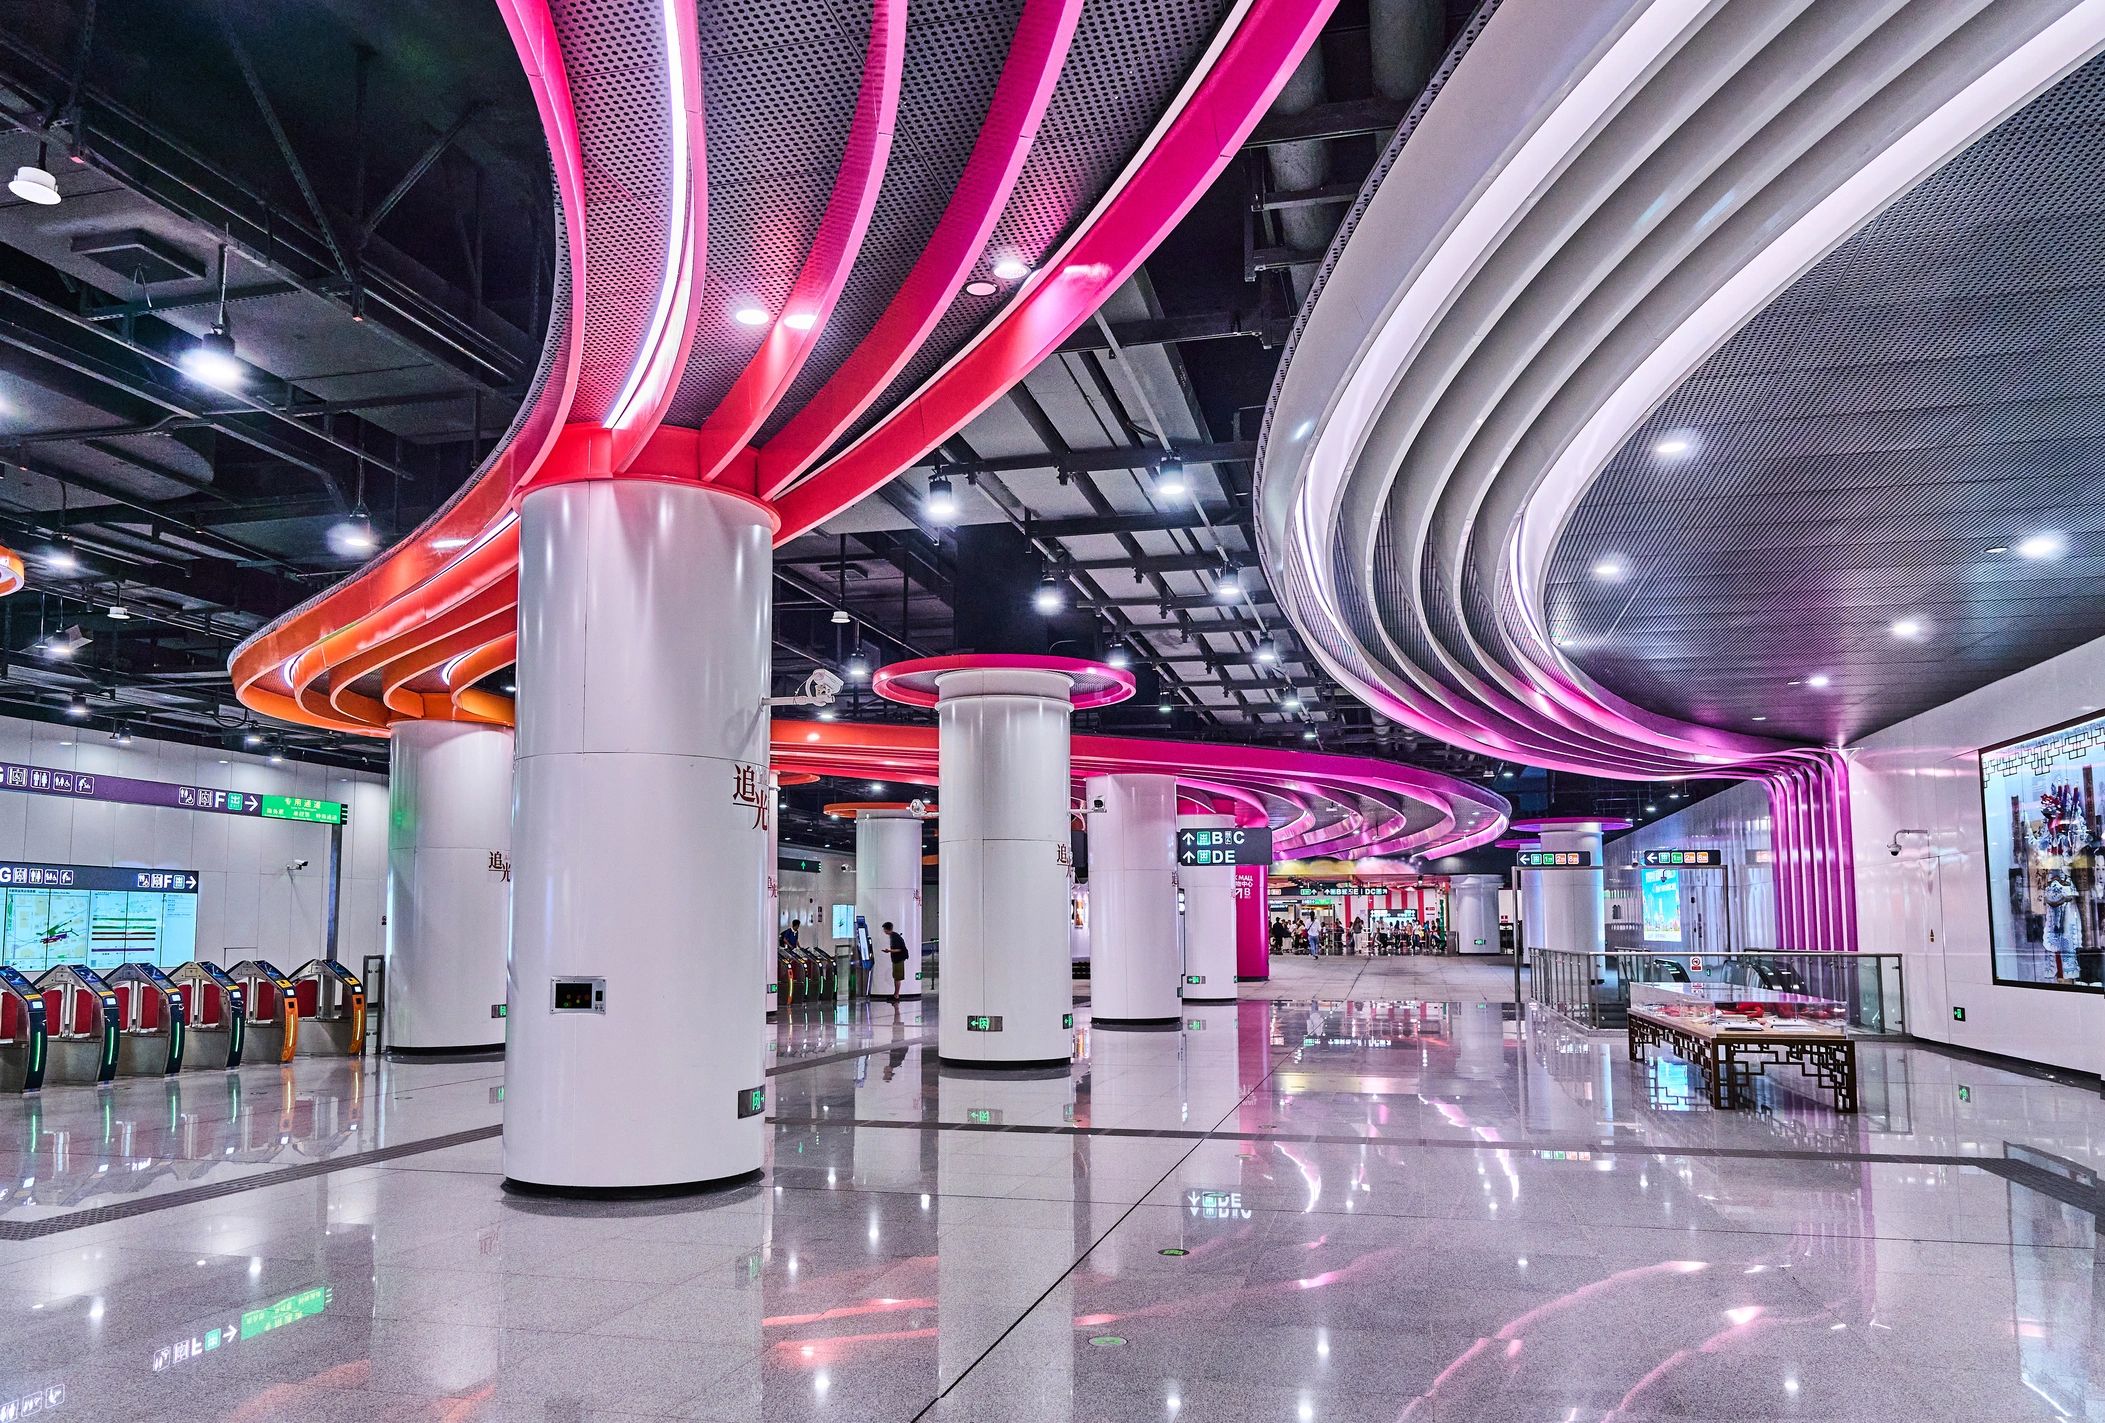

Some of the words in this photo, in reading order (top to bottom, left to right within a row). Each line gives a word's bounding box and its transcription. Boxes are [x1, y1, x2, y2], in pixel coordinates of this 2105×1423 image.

[214, 791, 227, 808] F
[1212, 831, 1223, 845] B
[1233, 831, 1245, 845] C
[0, 867, 12, 883] G
[163, 874, 173, 888] F
[1244, 887, 1251, 896] B
